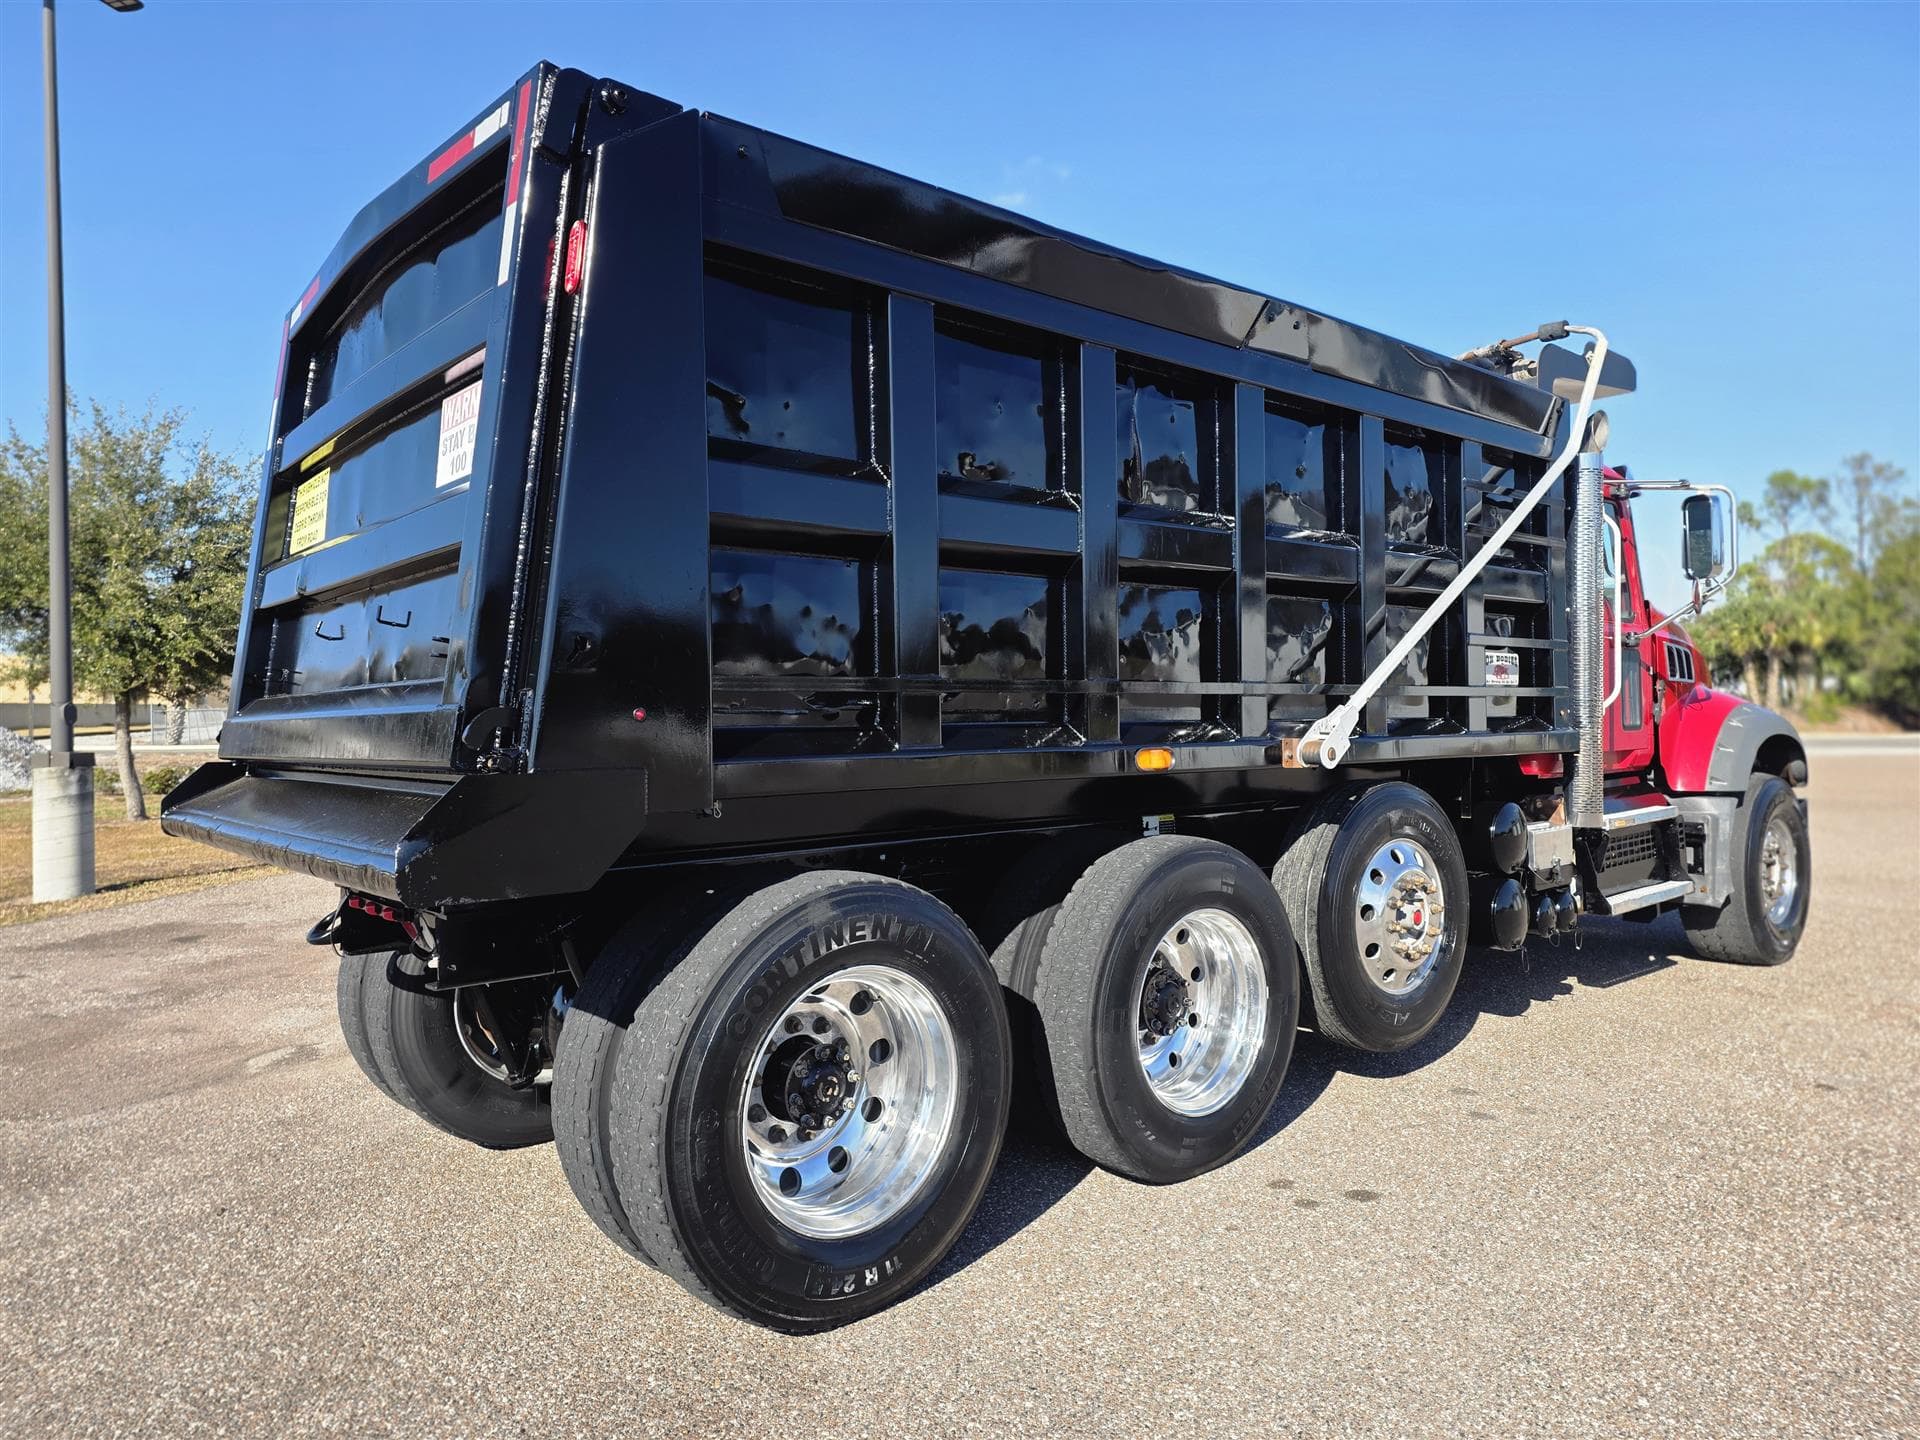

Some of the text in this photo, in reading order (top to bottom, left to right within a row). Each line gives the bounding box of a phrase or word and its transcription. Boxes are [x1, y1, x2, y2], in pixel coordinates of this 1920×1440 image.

[442, 428, 466, 456] STAY
[450, 451, 467, 475] 100
[726, 913, 938, 1037] CONTINENTAL
